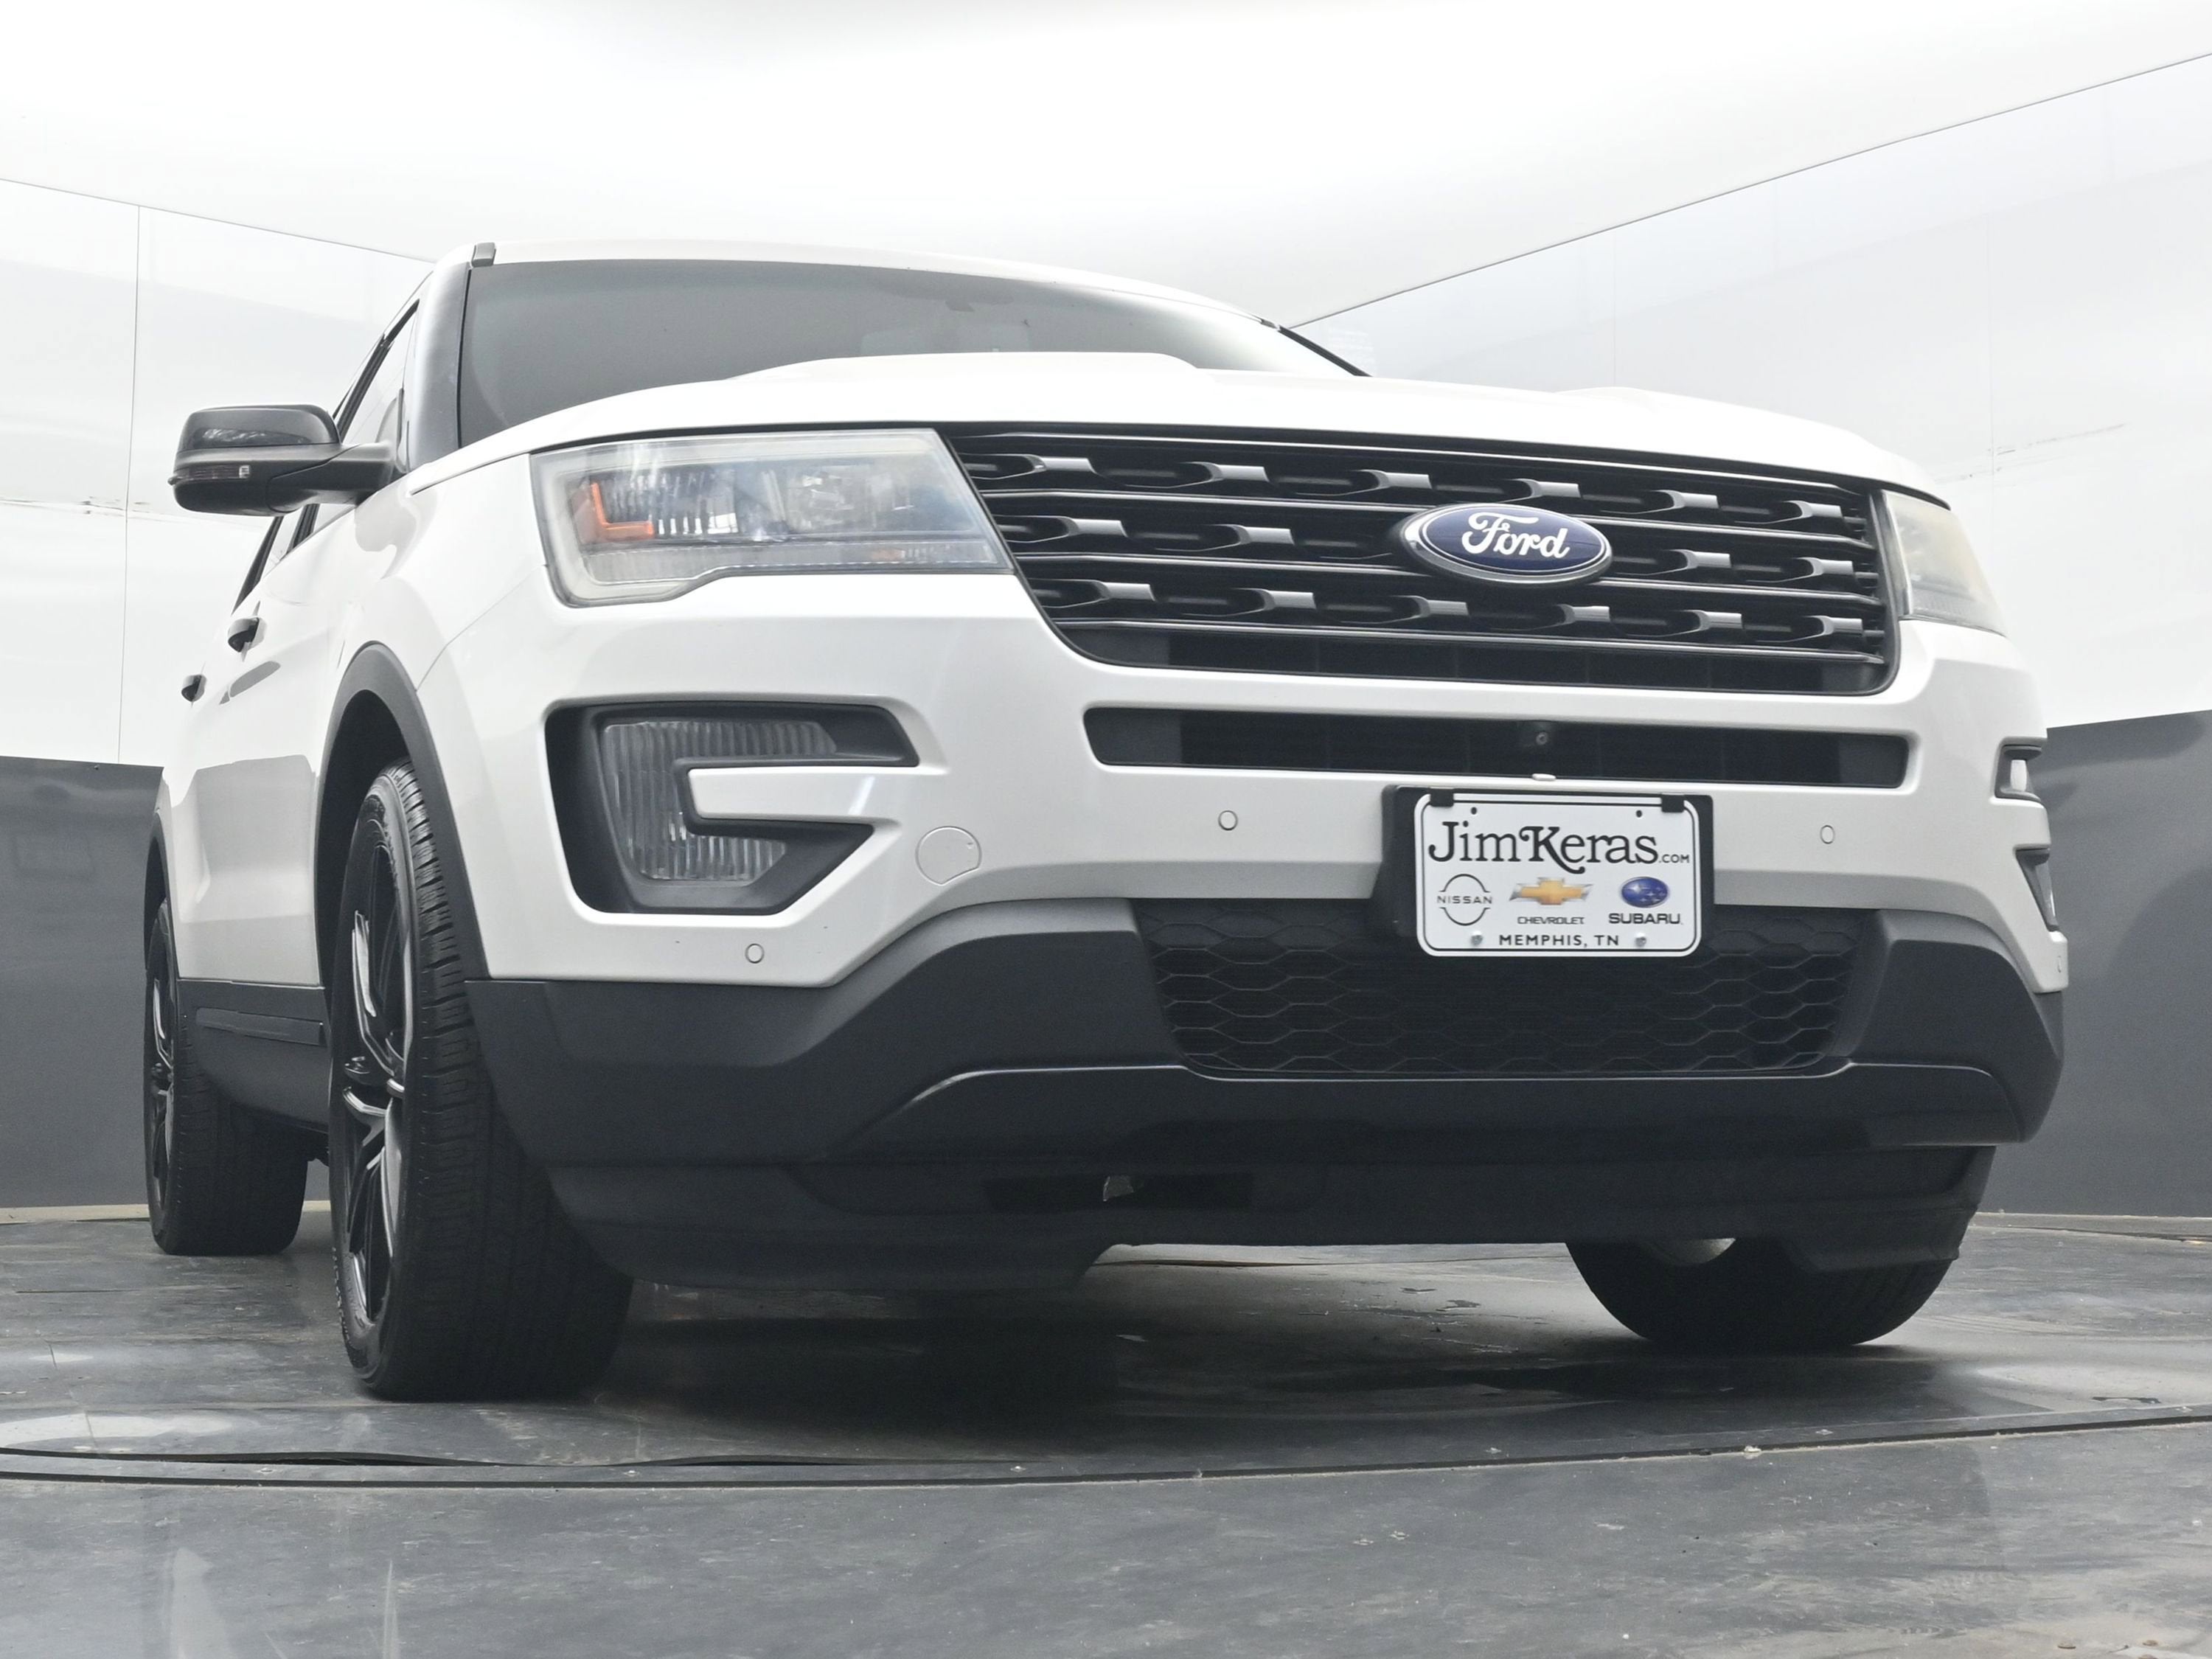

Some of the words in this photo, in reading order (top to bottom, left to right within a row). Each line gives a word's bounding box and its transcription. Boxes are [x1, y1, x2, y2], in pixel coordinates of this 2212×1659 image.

[1461, 512, 1570, 558] Ford
[1437, 895, 1492, 905] NISSAN
[1517, 916, 1585, 925] CHEVROLET
[1608, 913, 1681, 925] SUBARU
[1499, 934, 1587, 948] MEMPHIS,
[1594, 935, 1619, 946] TN
